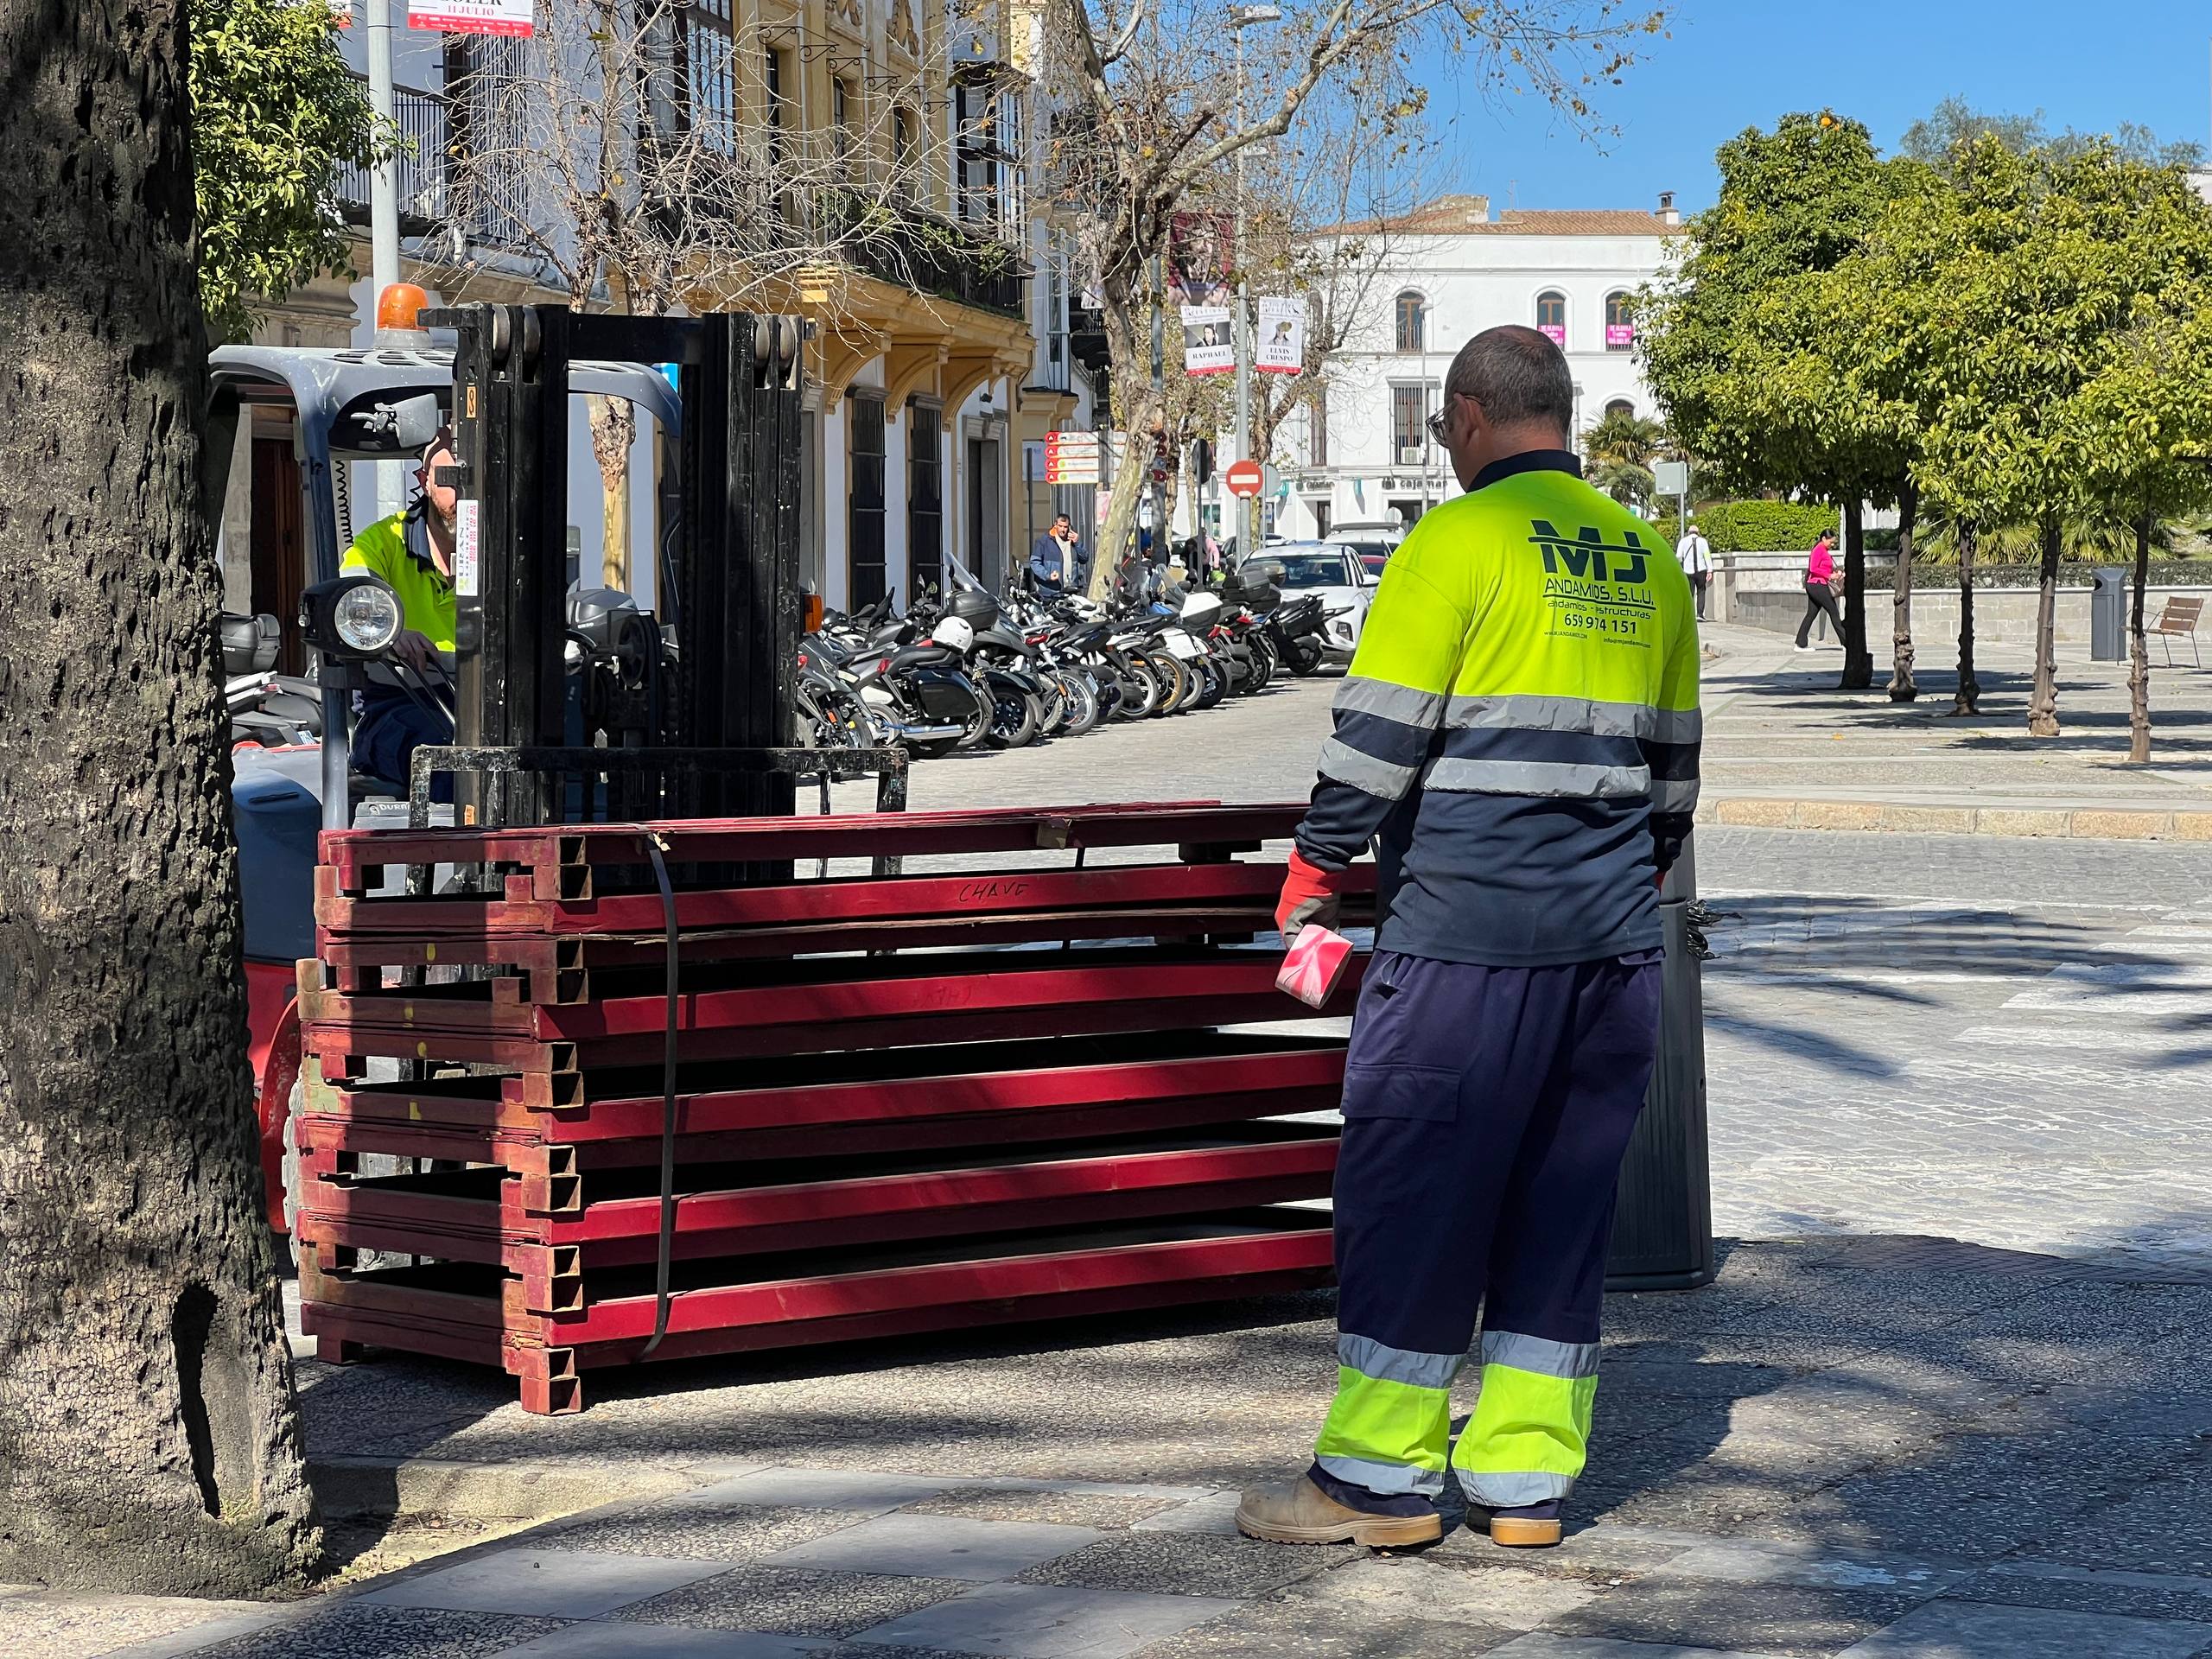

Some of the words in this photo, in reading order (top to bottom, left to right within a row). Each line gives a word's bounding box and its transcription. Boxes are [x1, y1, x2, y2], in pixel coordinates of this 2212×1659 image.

[459, 6, 494, 16] JULIO
[1192, 351, 1225, 359] RAPHAEL
[1529, 519, 1651, 584] MJ
[1618, 587, 1654, 605] S.L.U.
[1564, 613, 1583, 626] 659
[1586, 616, 1606, 631] 974
[1611, 620, 1636, 634] 151
